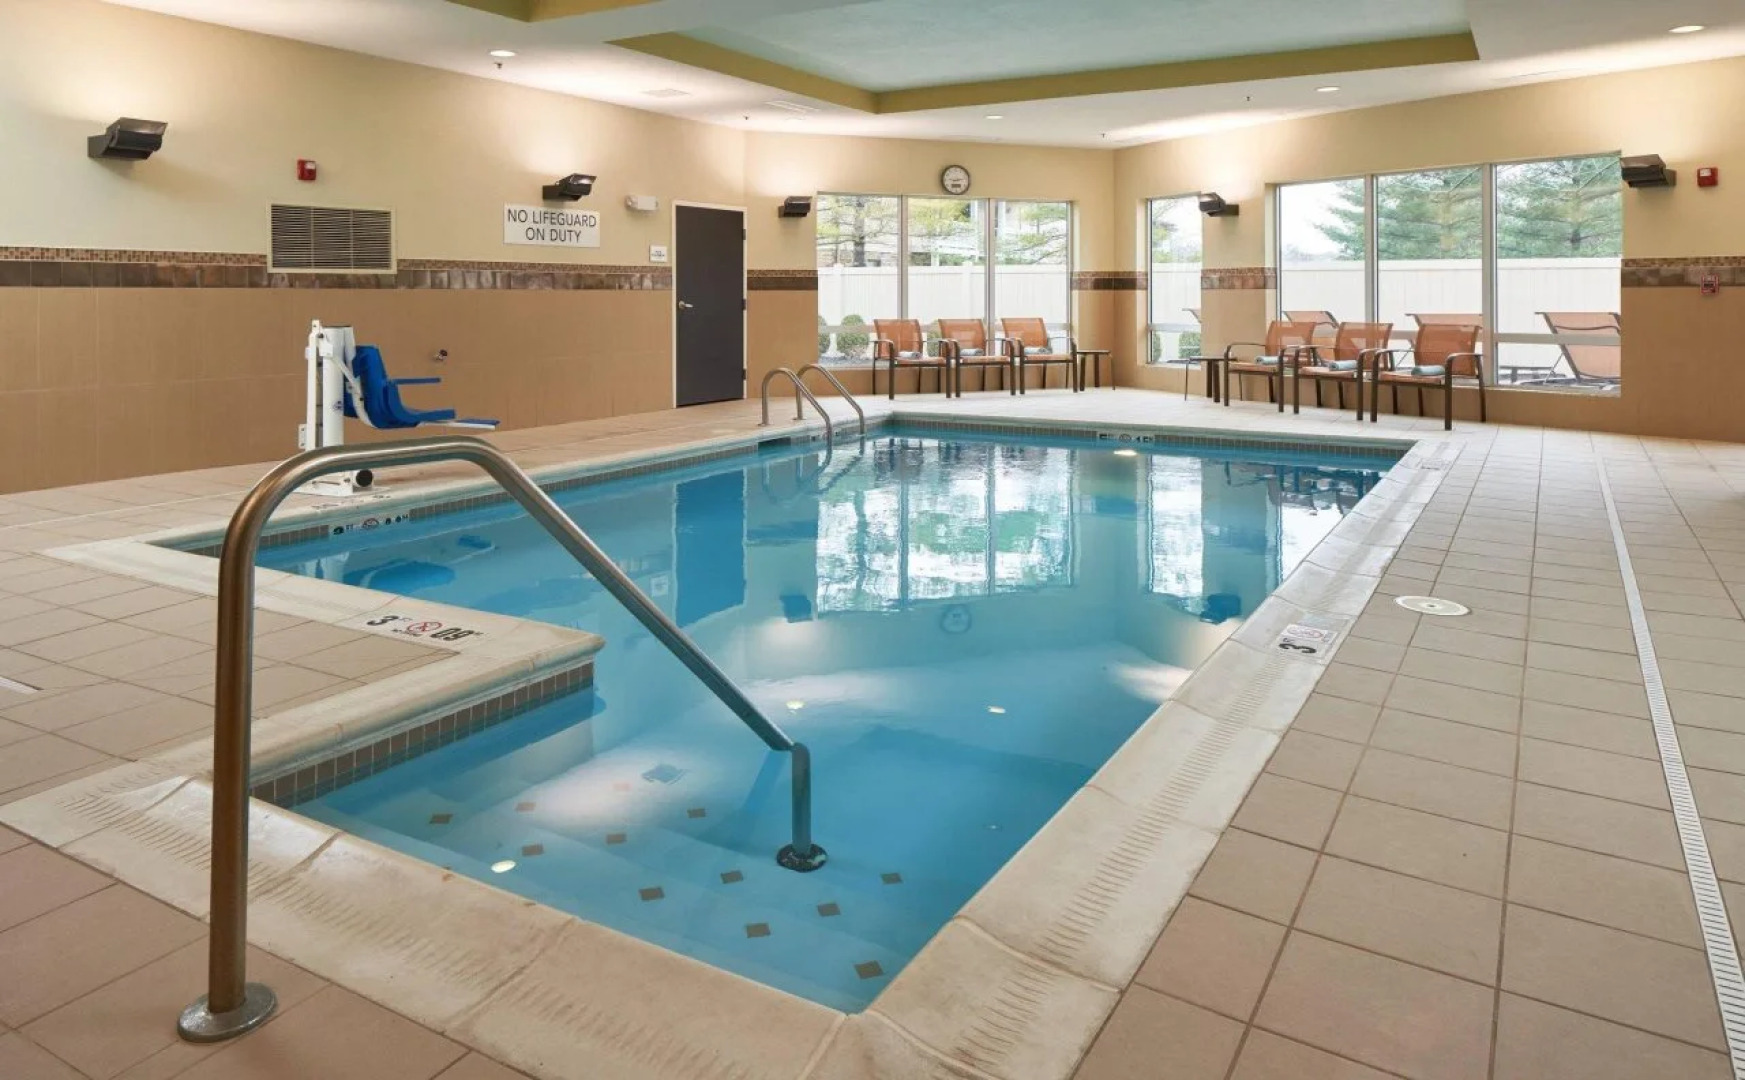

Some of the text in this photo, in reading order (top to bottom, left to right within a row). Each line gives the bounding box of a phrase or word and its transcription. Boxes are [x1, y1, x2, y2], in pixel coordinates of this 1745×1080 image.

[507, 209, 596, 227] NO LIFEGUARD
[525, 227, 581, 242] ON DUTY
[366, 615, 400, 626] 3
[1278, 643, 1317, 653] 3
